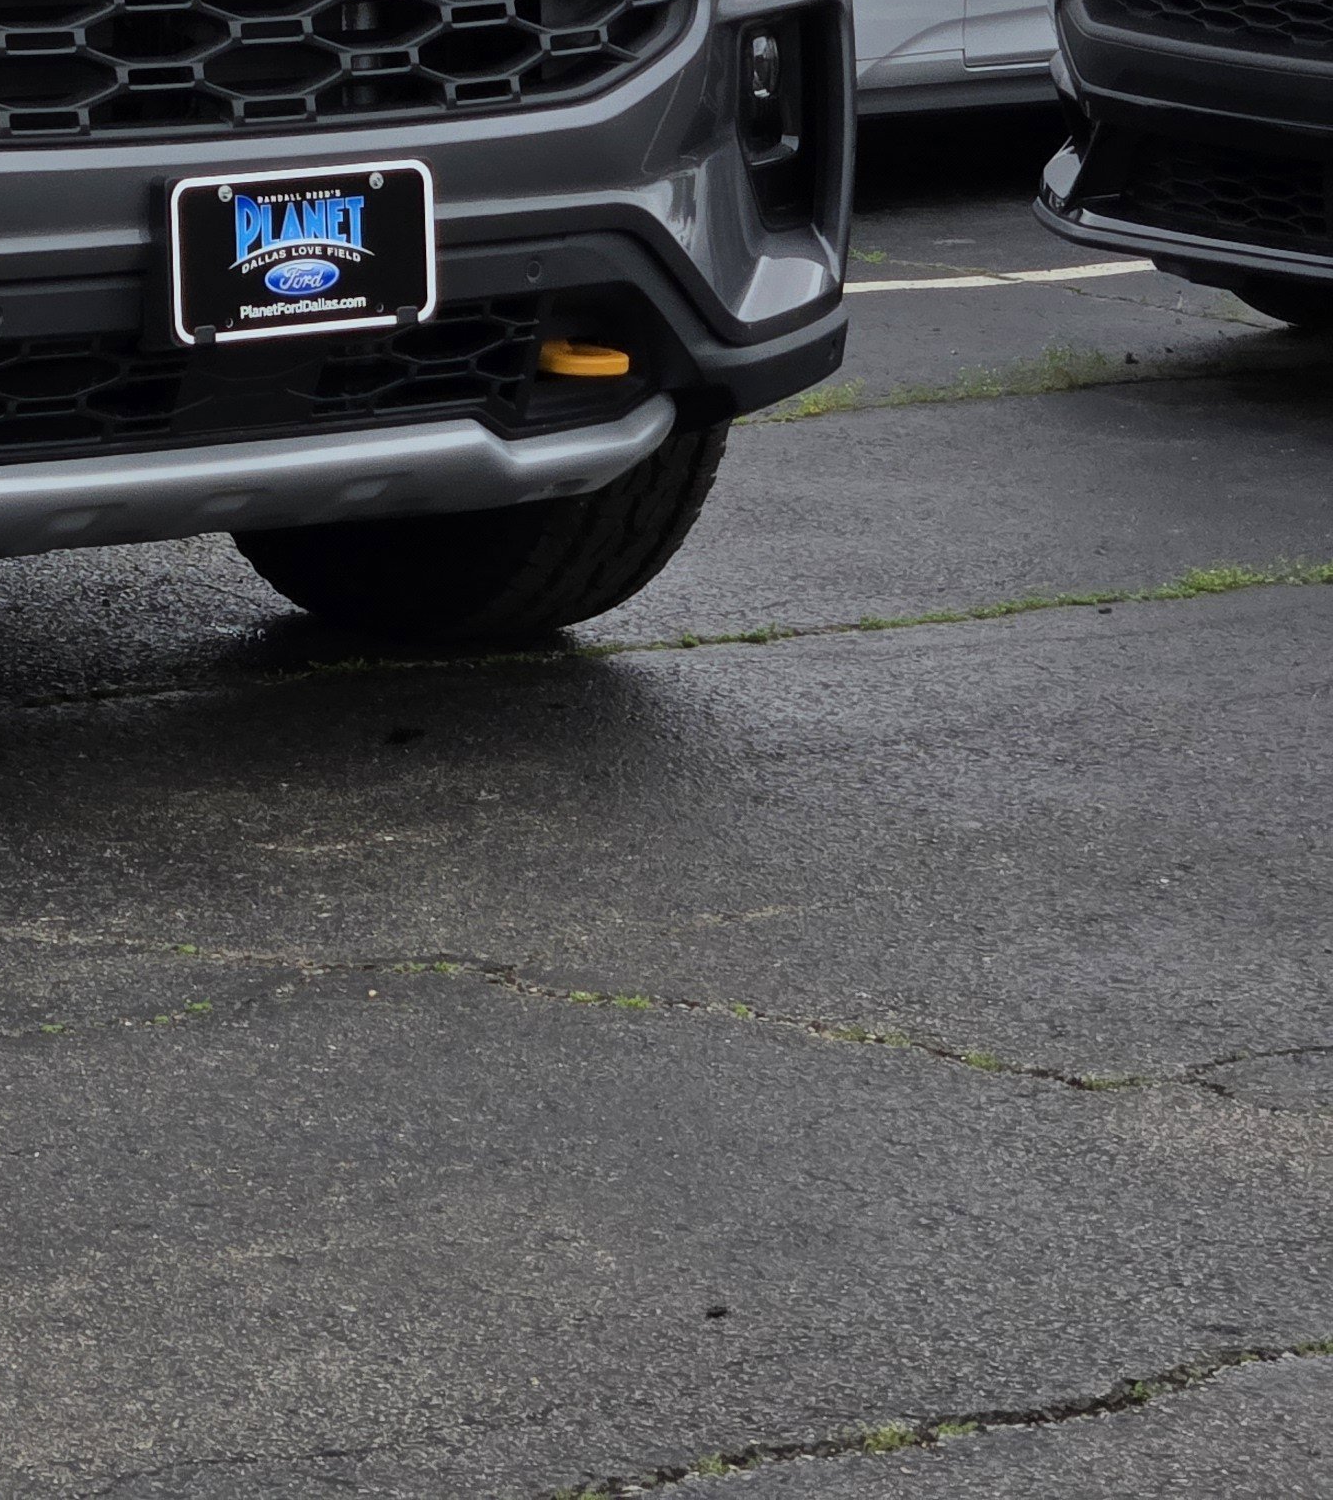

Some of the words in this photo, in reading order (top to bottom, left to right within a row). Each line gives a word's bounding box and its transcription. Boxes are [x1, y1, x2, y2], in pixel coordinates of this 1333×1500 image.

[235, 194, 365, 264] PLANET
[241, 252, 287, 274] DALLAS
[291, 246, 323, 257] LOVE
[327, 246, 362, 263] FIELD
[278, 266, 325, 290] Ford
[239, 296, 367, 320] PlanetFordDallas.com
